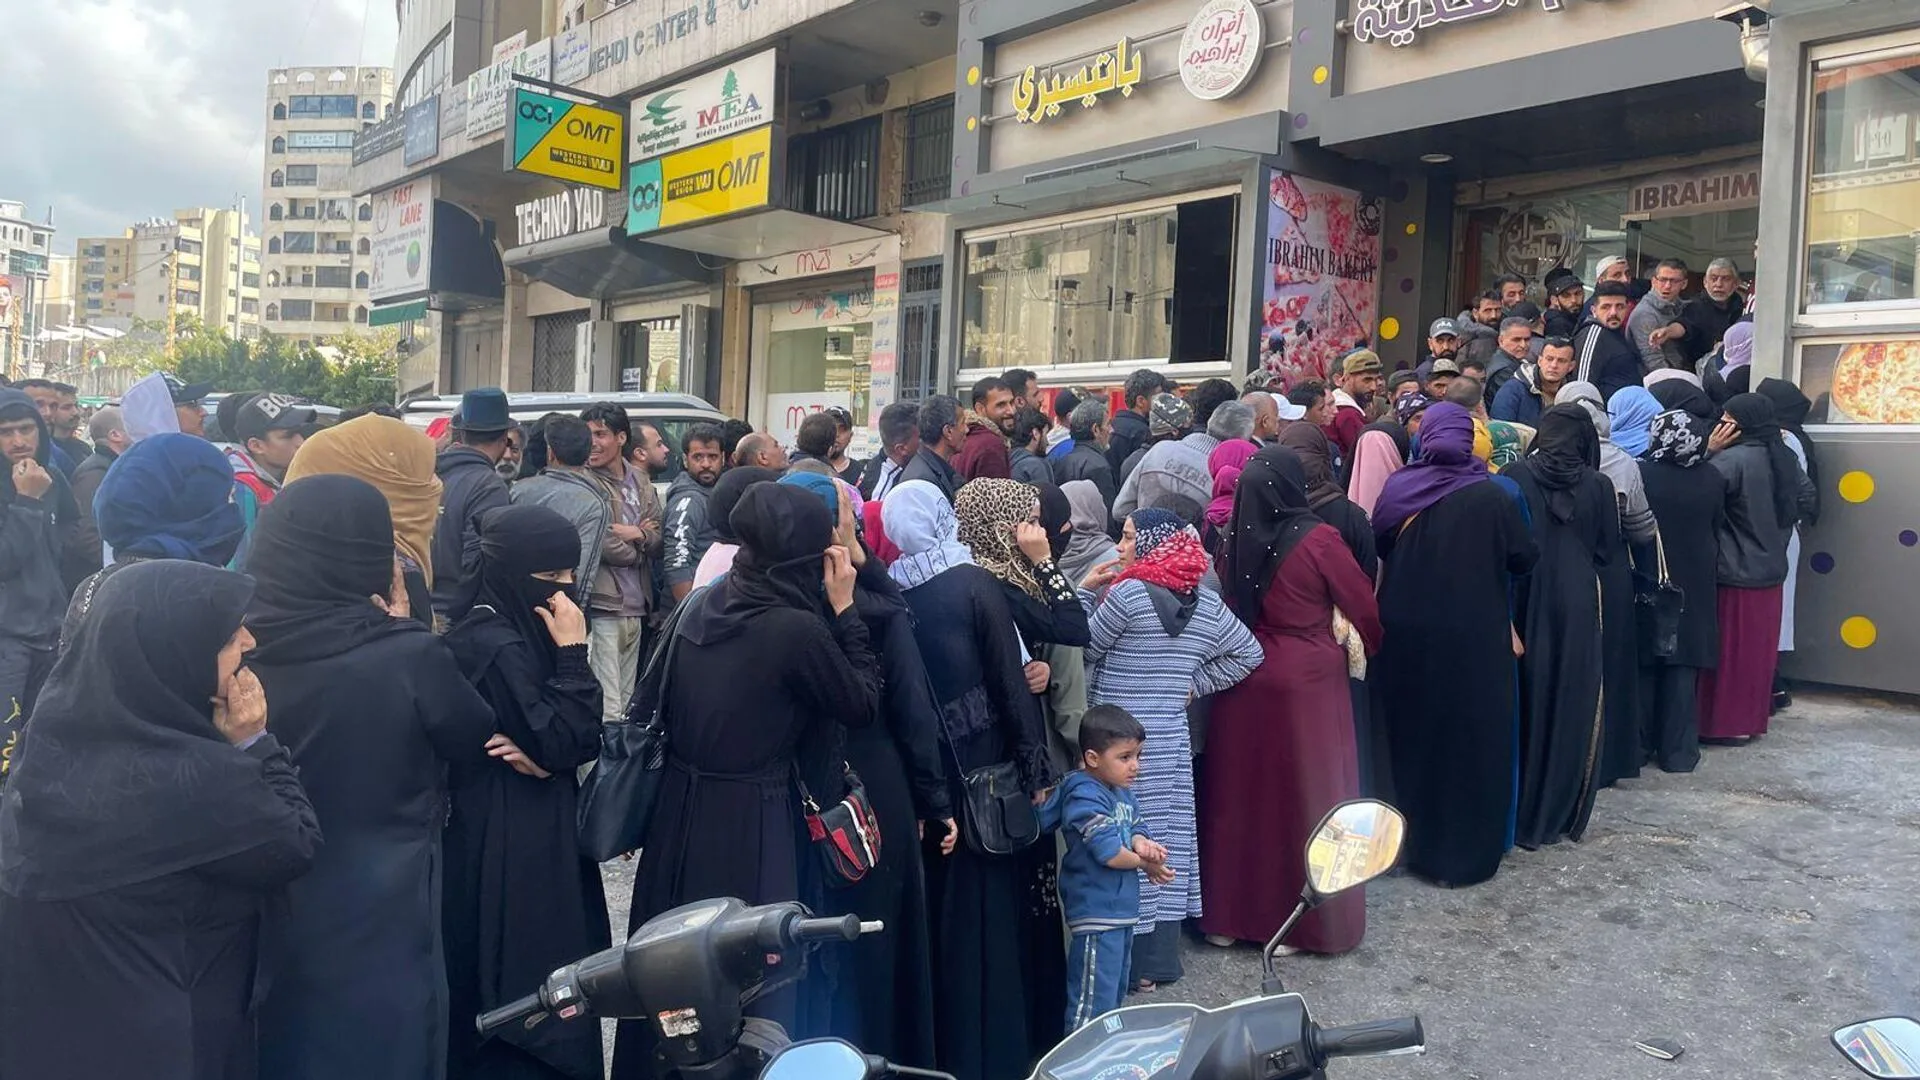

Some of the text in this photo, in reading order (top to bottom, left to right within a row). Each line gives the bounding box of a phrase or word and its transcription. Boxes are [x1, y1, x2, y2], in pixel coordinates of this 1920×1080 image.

[1202, 5, 1246, 44] أفران
[1184, 34, 1247, 69] إبراهيم
[1012, 36, 1142, 123] باتيسيري
[696, 92, 762, 130] MEA
[567, 118, 616, 144] OMT
[718, 151, 765, 192] OMT
[393, 183, 414, 208] FAST
[1634, 172, 1758, 212] IBRAHIM
[400, 203, 423, 227] LANE
[515, 187, 603, 245] TECHNO YAD
[1268, 237, 1377, 283] IBRAHIM BAKERY
